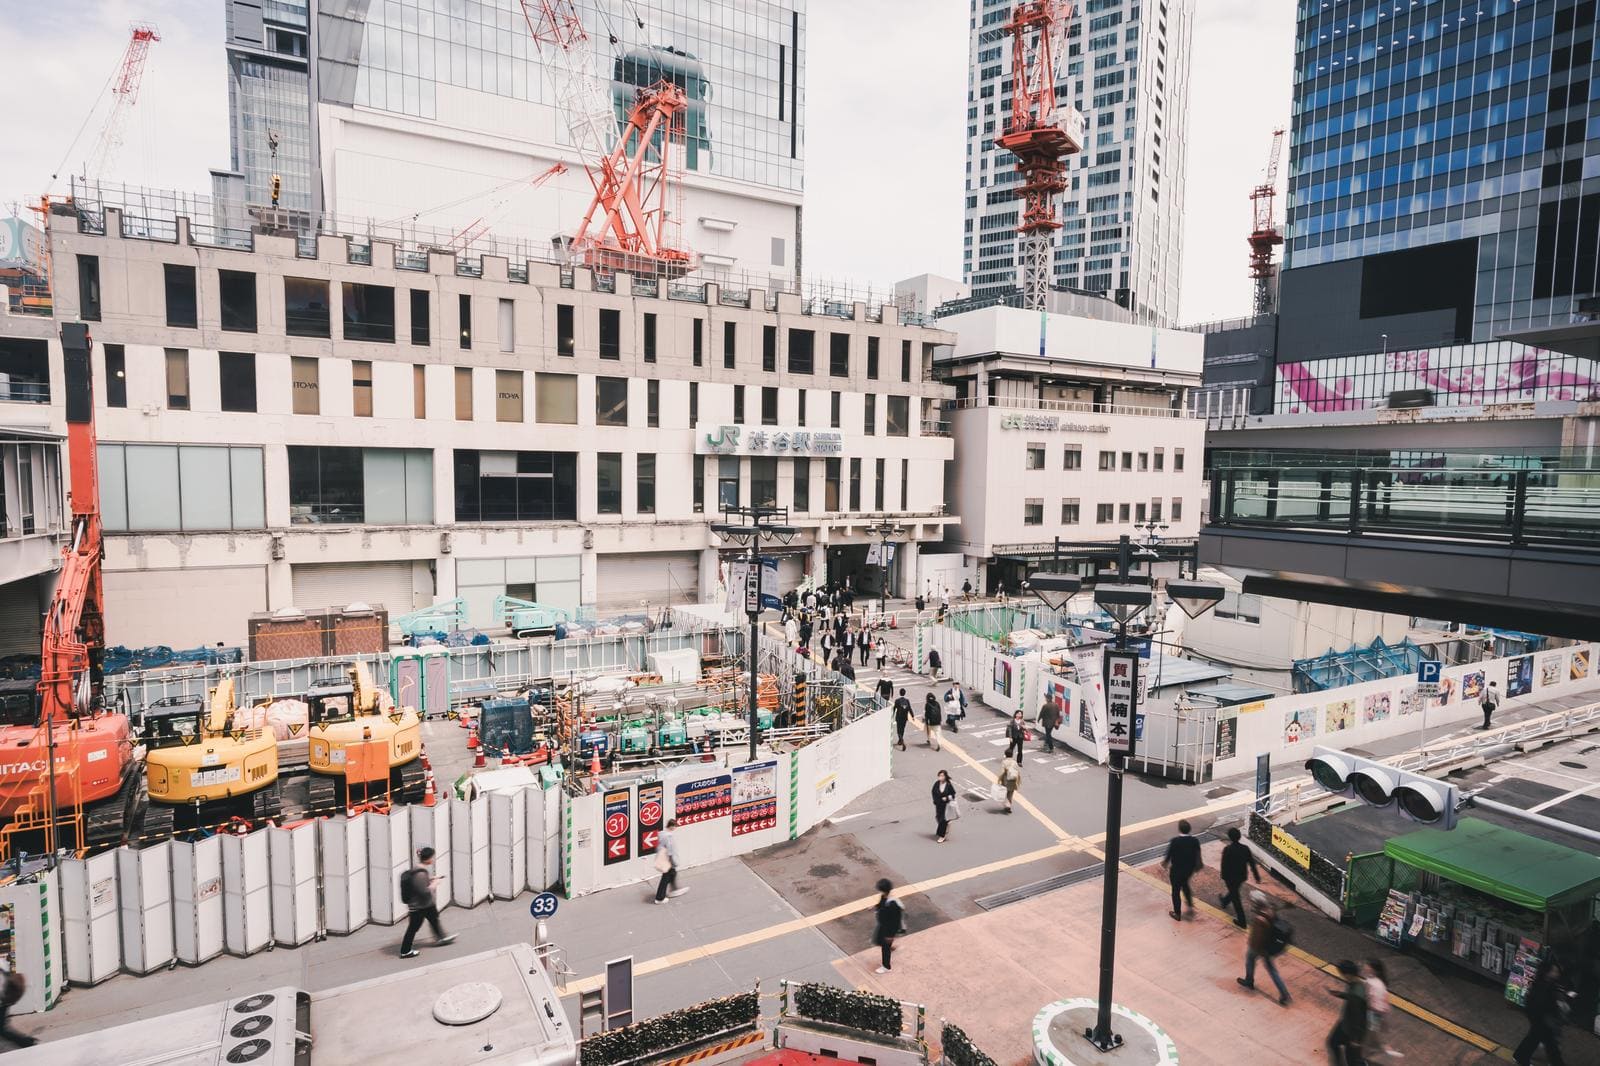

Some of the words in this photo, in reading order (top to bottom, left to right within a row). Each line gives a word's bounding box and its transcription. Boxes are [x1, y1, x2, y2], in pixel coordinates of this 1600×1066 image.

[707, 426, 740, 446] JR
[749, 431, 811, 452] 渋谷駅
[1113, 663, 1128, 678] 質
[1424, 664, 1436, 681] P
[1110, 702, 1128, 737] 楠本
[691, 779, 717, 789] バスのりば
[642, 806, 660, 822] 32
[608, 816, 624, 833] 31
[533, 897, 555, 913] 33
